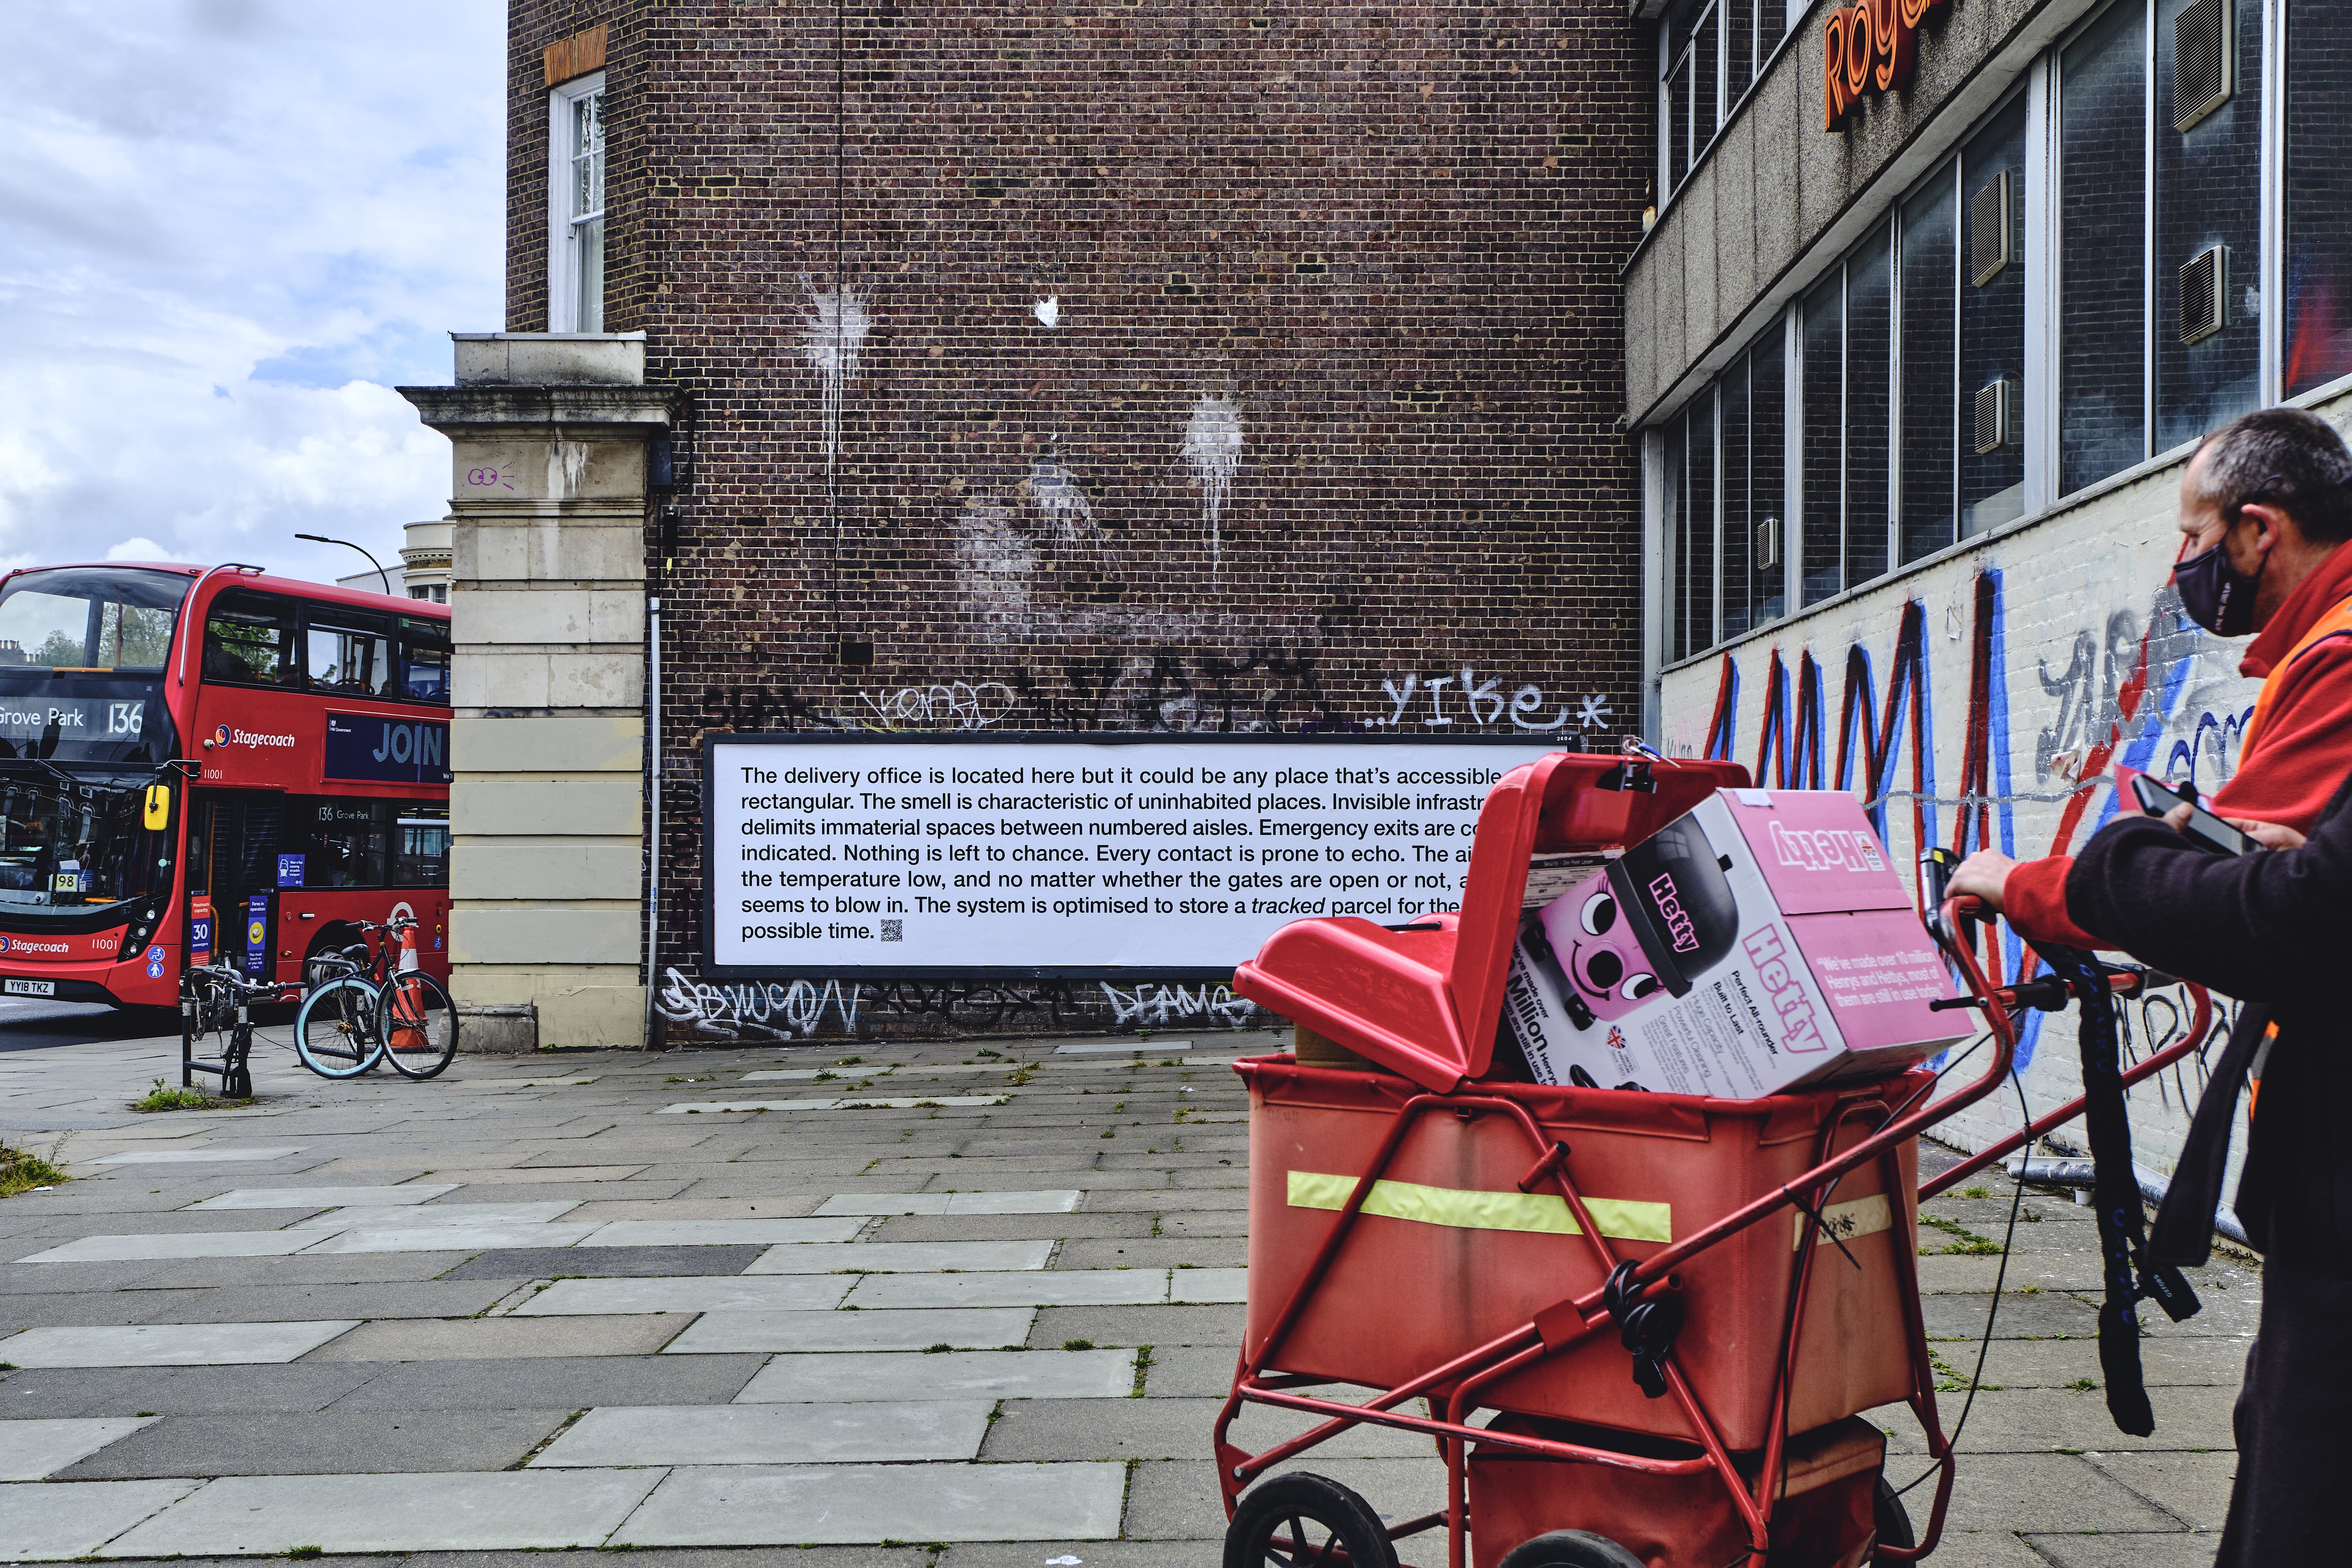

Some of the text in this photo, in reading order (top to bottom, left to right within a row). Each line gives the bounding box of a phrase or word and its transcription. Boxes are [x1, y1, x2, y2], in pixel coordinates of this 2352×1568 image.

[49, 708, 83, 726] Park
[109, 704, 143, 733] 136
[233, 729, 294, 748] Stagecoach
[372, 723, 442, 766] JOIN
[204, 769, 222, 779] 11001
[741, 768, 777, 783] The
[785, 768, 860, 787] delivery
[868, 768, 921, 783] office
[930, 768, 944, 783] is
[953, 768, 1023, 783] located
[1033, 768, 1074, 783] here
[1083, 768, 1113, 783] but
[1122, 768, 1132, 783] it
[1140, 768, 1193, 783] could
[1202, 768, 1225, 783] be
[1234, 771, 1267, 788] any
[1276, 768, 1328, 787] place
[1397, 768, 1501, 784] accessible
[742, 793, 853, 813] rectangular.
[860, 793, 895, 809] The
[902, 793, 950, 809] smell
[958, 793, 972, 809] is
[978, 793, 1108, 809] characteristic
[1114, 793, 1133, 809] of
[1139, 793, 1250, 809] uninhabited
[1258, 793, 1325, 813] places.
[1334, 793, 1410, 809] Invisible
[319, 807, 369, 821] 136 Grove Park
[742, 819, 815, 835] delimits
[822, 819, 919, 835] immaterial
[926, 823, 995, 839] spaces
[1001, 819, 1082, 835] between
[1090, 819, 1186, 835] numbered
[1193, 819, 1252, 835] aisles.
[1260, 819, 1368, 840] Emergency
[1374, 820, 1419, 835] exits
[1425, 824, 1455, 836] are
[742, 845, 836, 860] indicated.
[845, 845, 919, 865] Nothing
[927, 845, 942, 861] is
[950, 845, 980, 861] left
[986, 846, 1005, 861] to
[1013, 845, 1088, 861] chance.
[1098, 845, 1151, 865] Every
[1158, 846, 1232, 861] contact
[1240, 845, 1254, 861] is
[1263, 849, 1318, 865] prone
[1325, 846, 1344, 861] to
[1352, 846, 1404, 862] echo.
[1412, 846, 1448, 862] The
[1769, 820, 1869, 872] Hetty
[59, 876, 73, 887] 98
[741, 871, 772, 886] the
[779, 871, 900, 890] temperature
[909, 871, 945, 890] low,
[954, 871, 990, 887] and
[999, 875, 1022, 887] no
[1031, 872, 1095, 887] matter
[1102, 871, 1183, 887] whether
[1189, 871, 1220, 887] the
[1229, 872, 1283, 891] gates
[1291, 875, 1321, 887] are
[1330, 875, 1378, 891] open
[1387, 876, 1407, 887] or
[1415, 873, 1450, 891] not,
[742, 897, 1459, 917] seems to blow in. The system is optimised to store a tracked parcel for the
[1649, 872, 1700, 953] Hetty
[193, 924, 208, 940] 30
[742, 922, 874, 942] possible time.
[11, 939, 69, 954] Stagecoach
[92, 939, 117, 950] 11001
[1851, 954, 1878, 968] made
[1877, 955, 1896, 966] over
[1896, 951, 1908, 964] 10
[1907, 950, 1937, 963] million
[11, 981, 49, 993] YY18 TKZ
[1825, 975, 1861, 990] Henrys
[1859, 971, 1878, 986] and
[1907, 967, 1931, 981] most
[1929, 965, 1940, 979] of
[1523, 972, 1538, 997] made
[1537, 999, 1548, 1018] over
[1742, 923, 1828, 1054] Hetty
[1835, 993, 1861, 1007] them
[1860, 993, 1877, 1004] are
[1875, 988, 1893, 1003] still
[1900, 989, 1918, 1000] use
[1713, 982, 1744, 1035] Built to Last
[1731, 971, 1753, 1005] Perfect
[1749, 1006, 1779, 1055] All-rounder
[1506, 974, 1557, 1086] Million Henrys
[1692, 995, 1724, 1054] Huge Capacity
[1510, 1017, 1521, 1032] are
[1519, 1033, 1531, 1049] still
[1527, 1050, 1534, 1060] in
[1532, 1061, 1542, 1078] use
[1659, 1015, 1690, 1074] Great Features
[1673, 1006, 1694, 1041] Powerful
[1691, 1042, 1712, 1078] Cleaning
